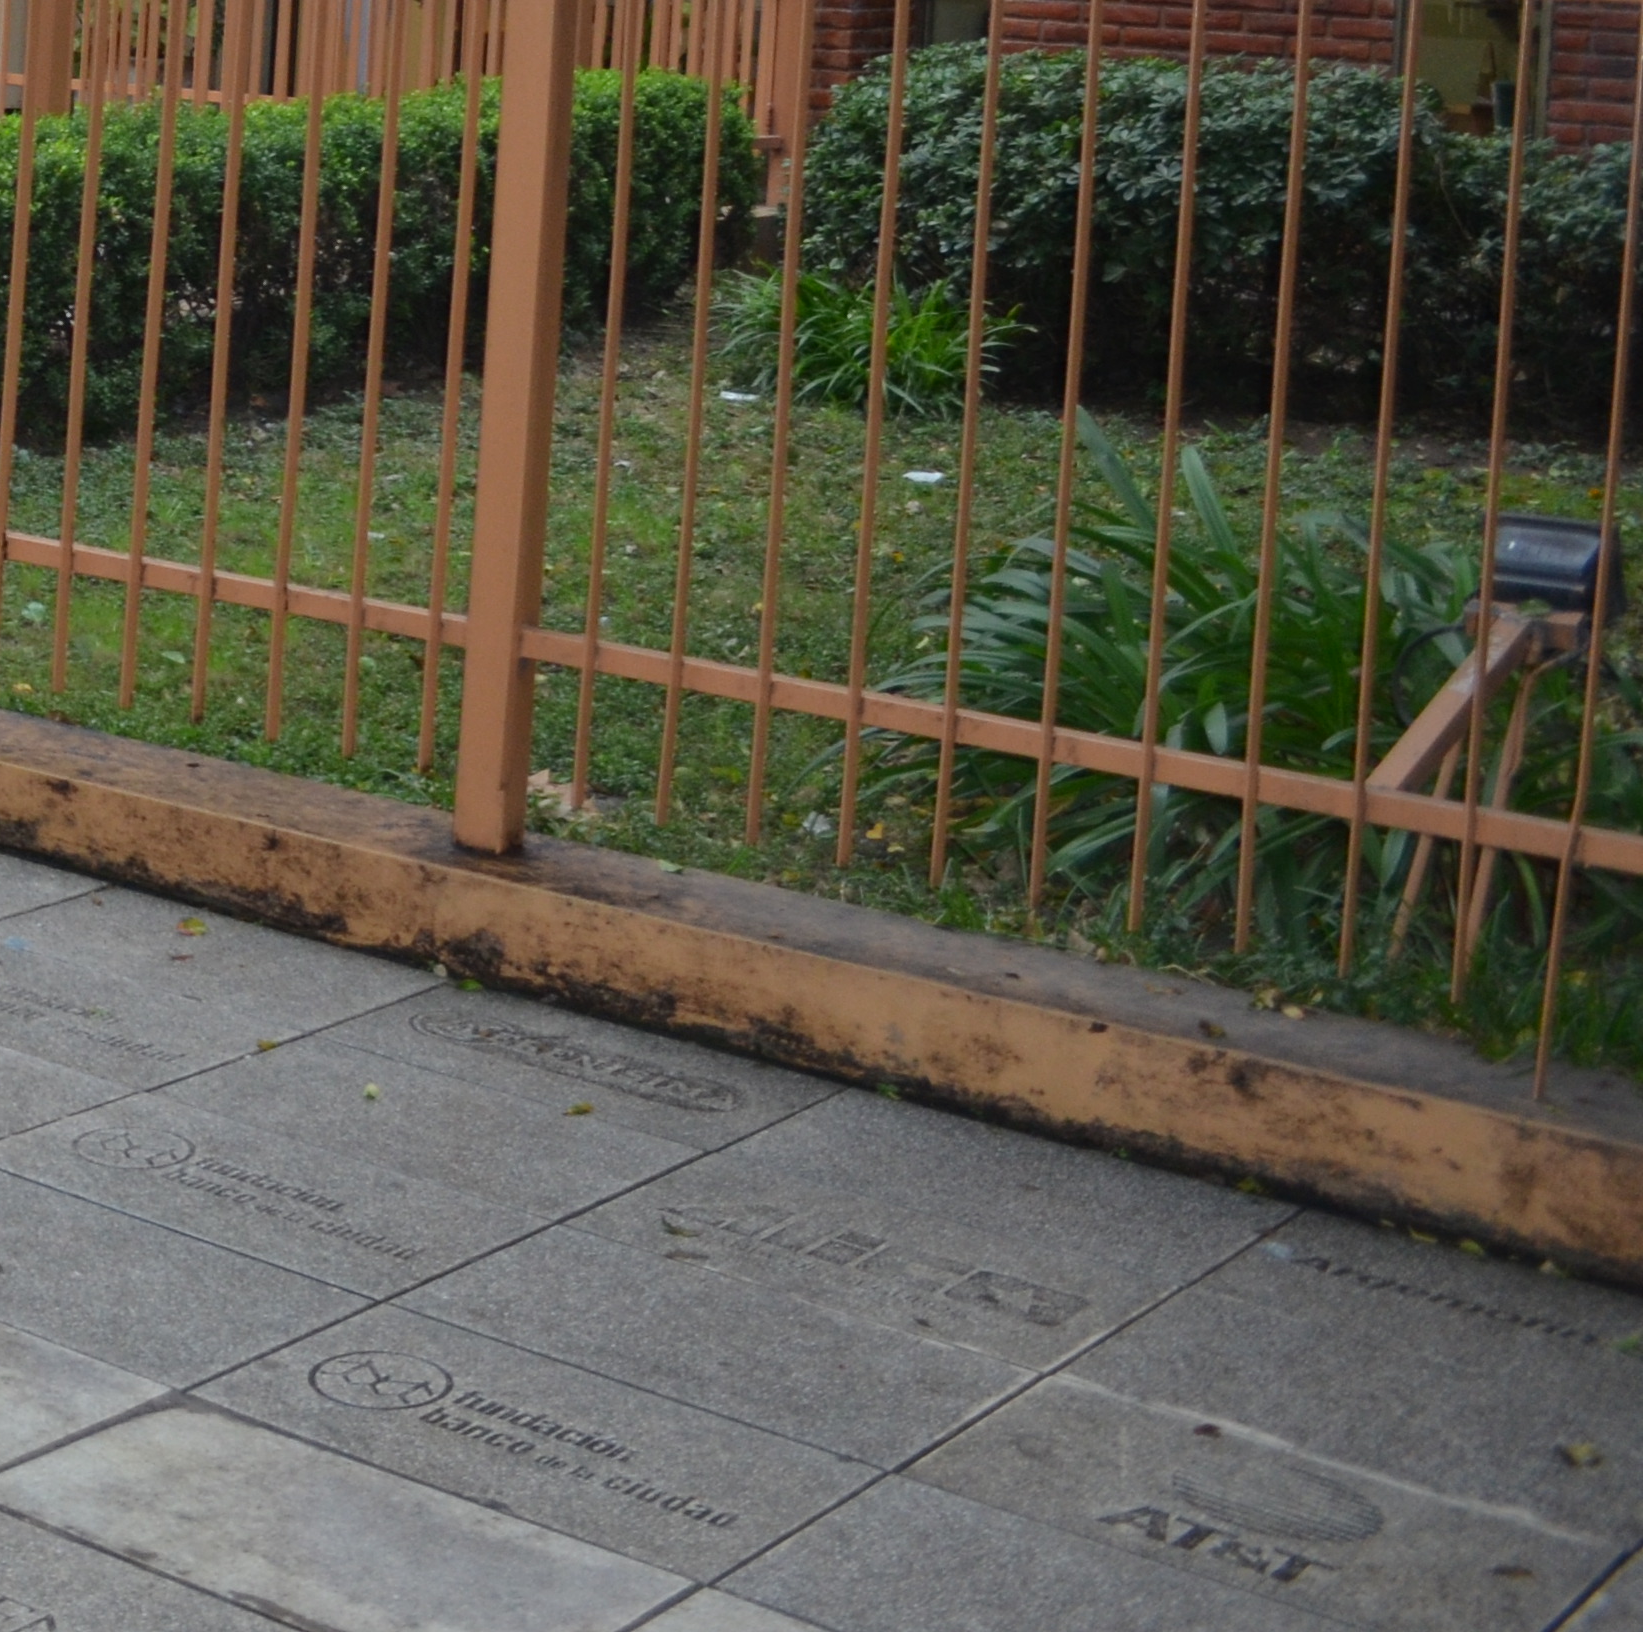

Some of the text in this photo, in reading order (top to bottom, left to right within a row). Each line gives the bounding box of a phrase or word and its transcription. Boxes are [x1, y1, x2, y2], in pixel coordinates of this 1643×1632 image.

[421, 1406, 740, 1529] banco de la ciudad
[1100, 1504, 1338, 1585] AT&T
